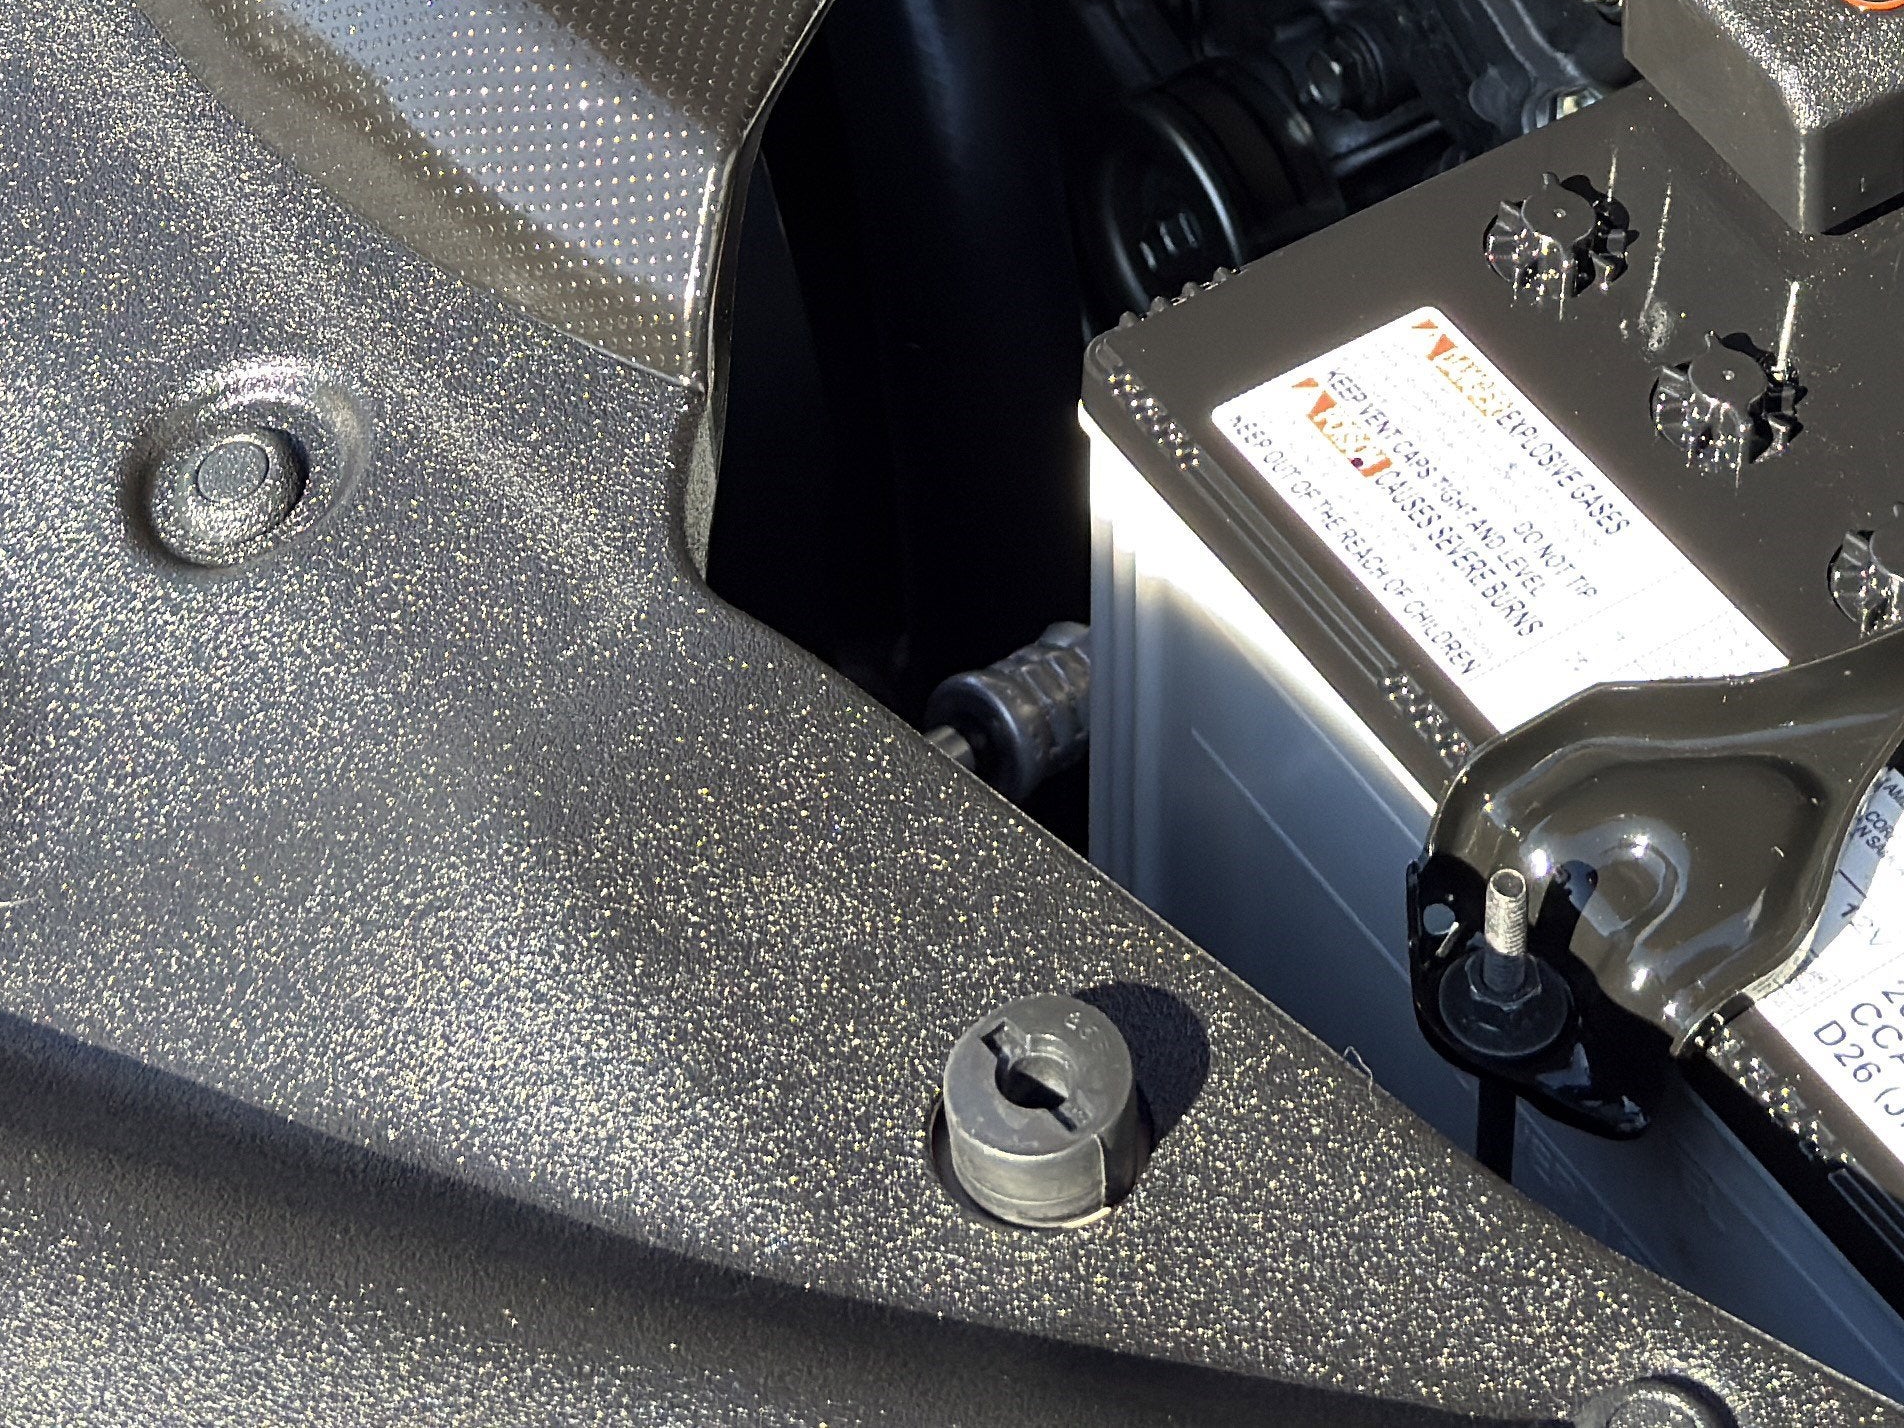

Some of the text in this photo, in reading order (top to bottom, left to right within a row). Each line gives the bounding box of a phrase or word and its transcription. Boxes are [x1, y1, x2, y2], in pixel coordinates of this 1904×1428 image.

[1373, 468, 1443, 532] CAUSES
[1427, 526, 1497, 588] SEVERE
[1479, 580, 1546, 639] BURNS
[1390, 438, 1439, 480] CAPS
[1466, 517, 1509, 552] AND
[1495, 546, 1550, 597] LEVEL
[1567, 482, 1632, 538] GASES
[1335, 527, 1394, 582] REACH
[1401, 598, 1482, 677] CHILDREN
[1811, 1019, 1883, 1085] D26
